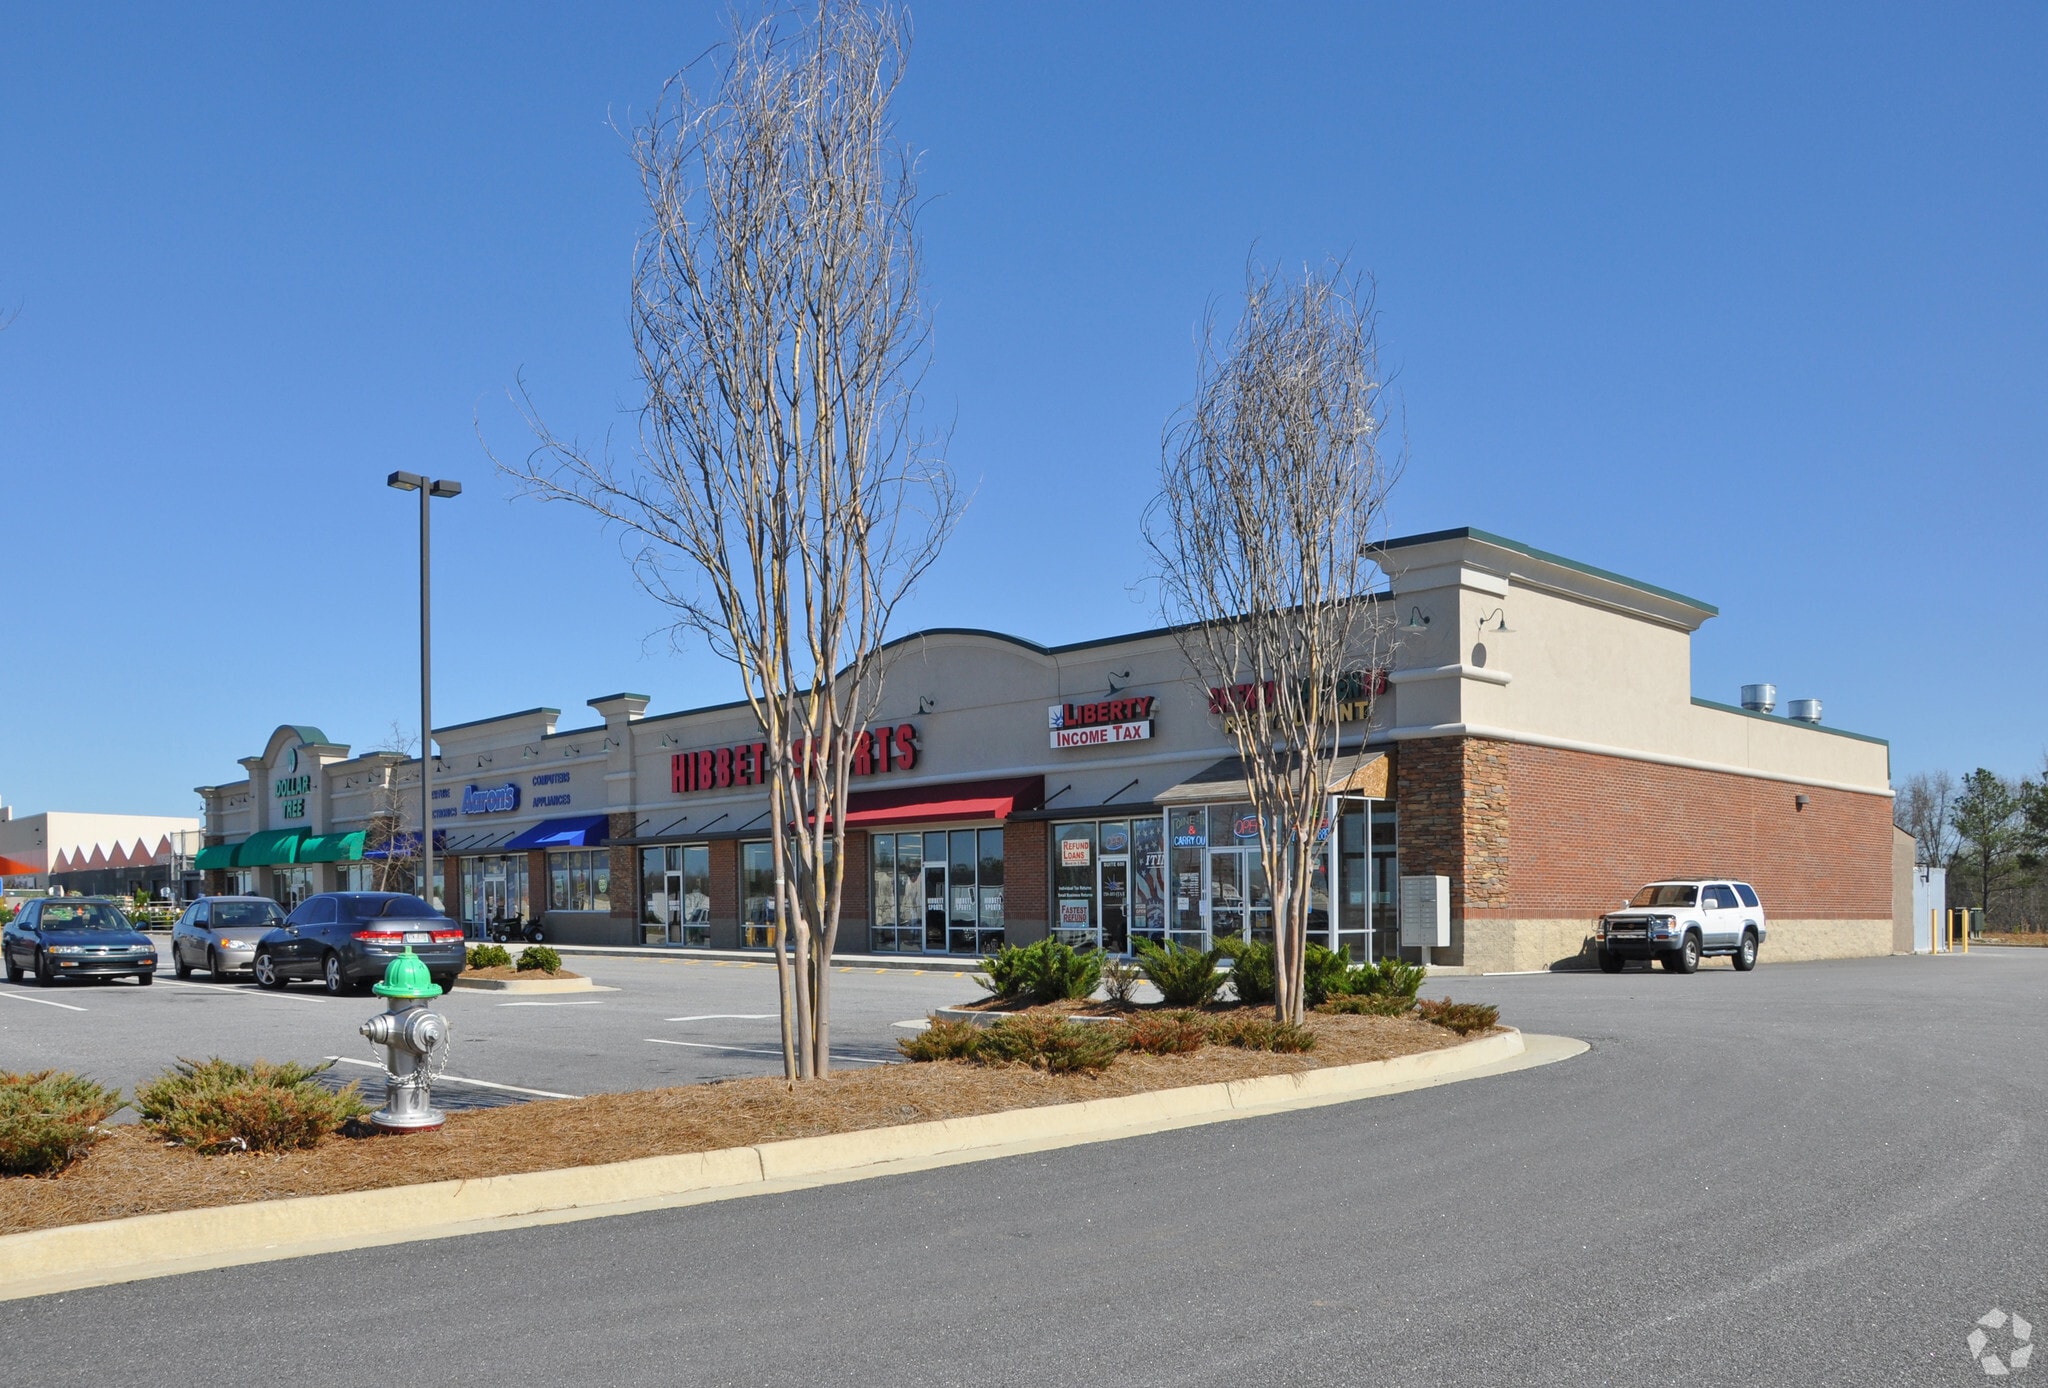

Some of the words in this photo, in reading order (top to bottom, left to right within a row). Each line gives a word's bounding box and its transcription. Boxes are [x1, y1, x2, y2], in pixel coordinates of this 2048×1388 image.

[1063, 696, 1154, 726] LIBERTY
[1224, 701, 1369, 734] RESTUNT
[1057, 728, 1108, 747] INCOME
[1113, 724, 1141, 740] TAX
[671, 743, 766, 793] HIBBET
[792, 723, 917, 781] SRTS
[275, 774, 310, 798] DOLLAR
[532, 772, 570, 786] COMPUTERS
[461, 783, 520, 815] Aaron's
[532, 794, 571, 808] APPLIANCES
[282, 799, 304, 818] TREE
[1188, 825, 1197, 835] &
[1235, 818, 1258, 834] OPE
[1063, 841, 1089, 850] REFUND
[1174, 836, 1195, 846] CARRY
[1196, 836, 1206, 846] OU
[1063, 850, 1085, 860] LOANS
[1061, 905, 1087, 914] FASTEST
[1064, 913, 1087, 922] REFUND
